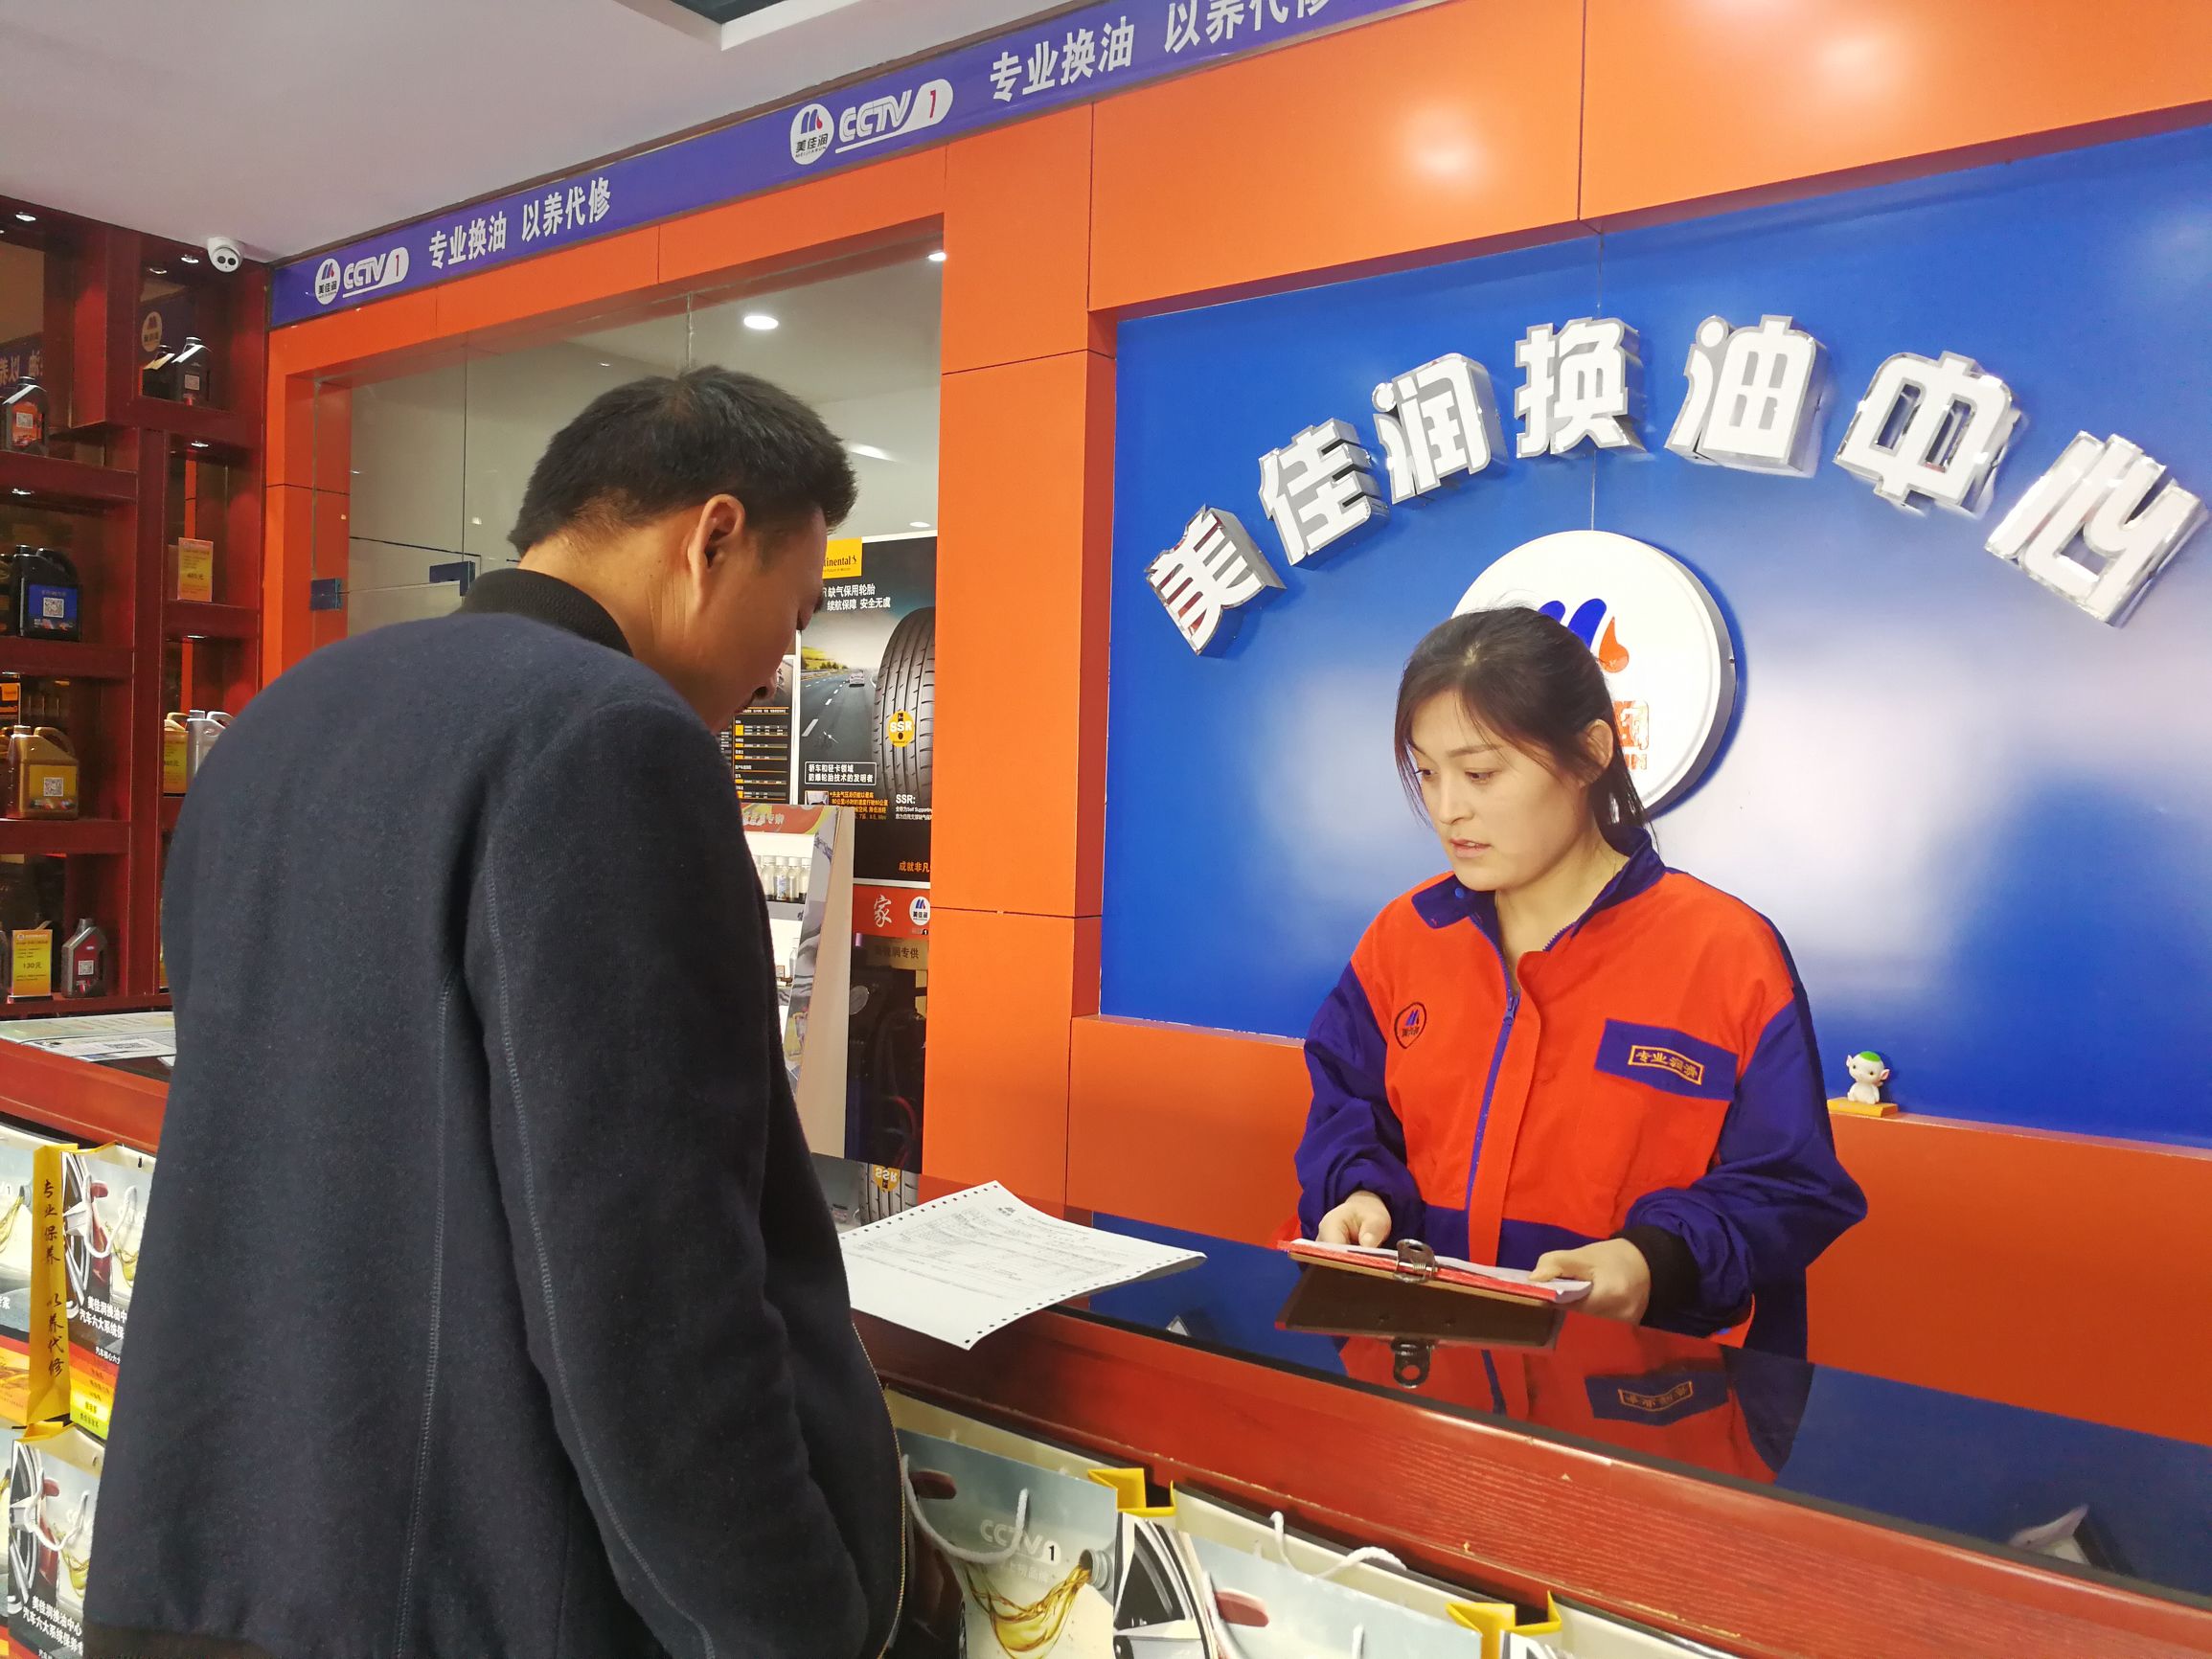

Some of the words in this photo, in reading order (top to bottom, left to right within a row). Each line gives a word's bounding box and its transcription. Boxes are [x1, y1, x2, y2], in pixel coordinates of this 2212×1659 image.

[990, 15, 1135, 103] 专业换油
[839, 89, 913, 143] CCTV
[929, 89, 937, 119] 1
[795, 133, 829, 153] 美佳润
[428, 211, 507, 269] 专业换油
[521, 177, 611, 242] 以养代修
[343, 253, 387, 290] CCTV
[395, 255, 399, 277] 1
[1145, 313, 2209, 656] 美佳润换油中心
[889, 720, 913, 733] SSR
[895, 793, 916, 805] SSR:
[44, 1179, 60, 1264] 专业保养
[0, 1295, 11, 1309] 家
[47, 1293, 64, 1377] 以养代修
[1049, 1545, 1055, 1561] 1
